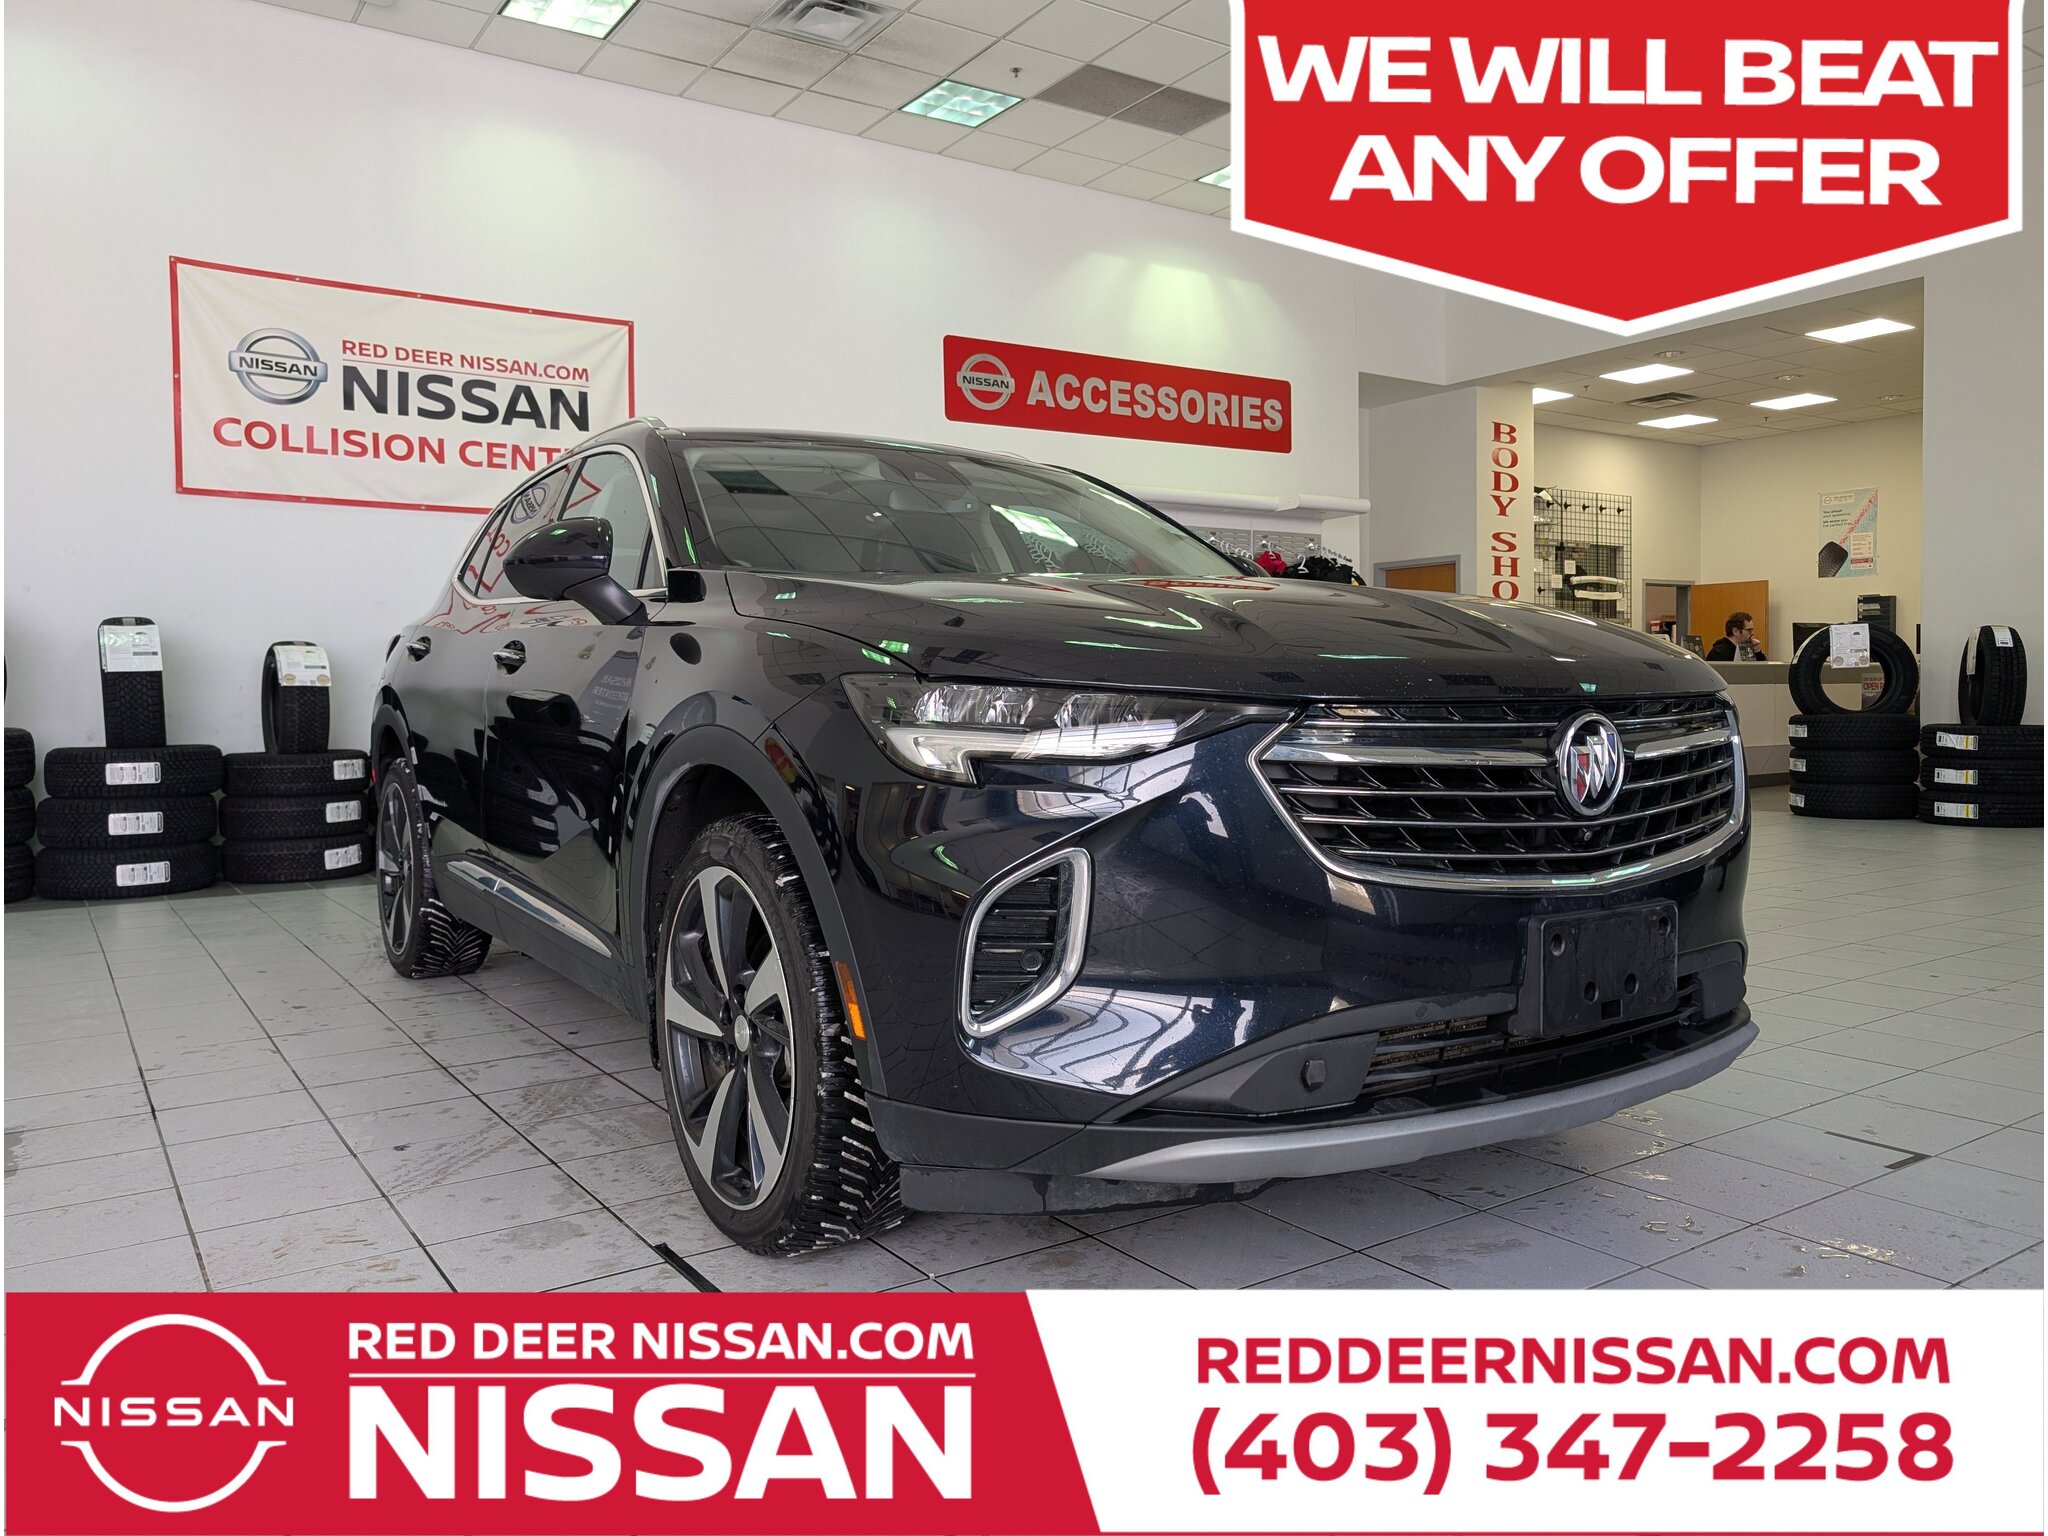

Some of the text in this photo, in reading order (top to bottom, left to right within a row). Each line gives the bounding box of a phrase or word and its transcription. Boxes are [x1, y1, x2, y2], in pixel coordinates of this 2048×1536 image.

[239, 355, 317, 377] NISSAN
[341, 339, 590, 383] RED DEER NISSAN.COM
[962, 375, 1010, 389] NISSAN
[342, 365, 590, 432] NISSAN
[1026, 371, 1284, 432] ACCESSORIES
[212, 417, 571, 472] COLLISION CENT
[1491, 422, 1520, 517] BODY
